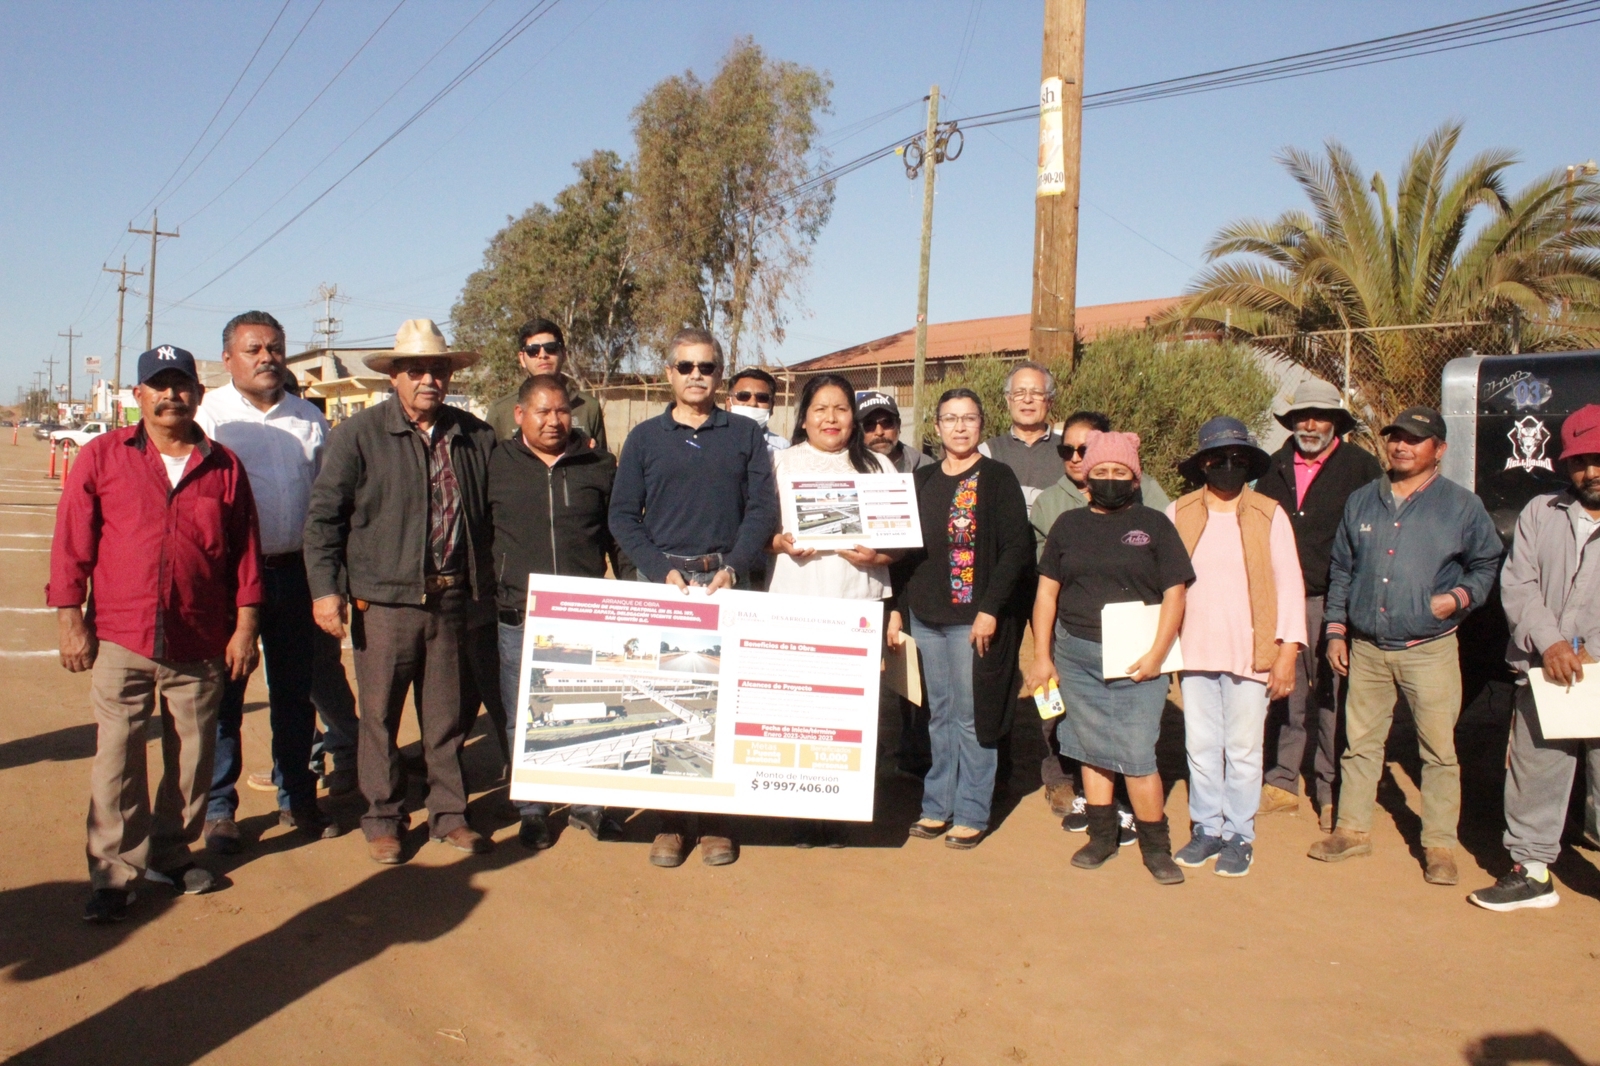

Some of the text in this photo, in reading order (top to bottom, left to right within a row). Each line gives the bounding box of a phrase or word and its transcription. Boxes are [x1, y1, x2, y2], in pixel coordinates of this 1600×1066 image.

[1517, 380, 1540, 404] 03
[859, 398, 887, 410] PUMA
[602, 598, 633, 606] ARRANQUE
[771, 615, 816, 623] DESARROLLO
[744, 640, 779, 650] Beneficios
[742, 681, 771, 689] Alcances
[751, 742, 777, 750] Metas
[814, 752, 848, 762] 10,000
[756, 771, 784, 779] Monto
[751, 779, 759, 790] $
